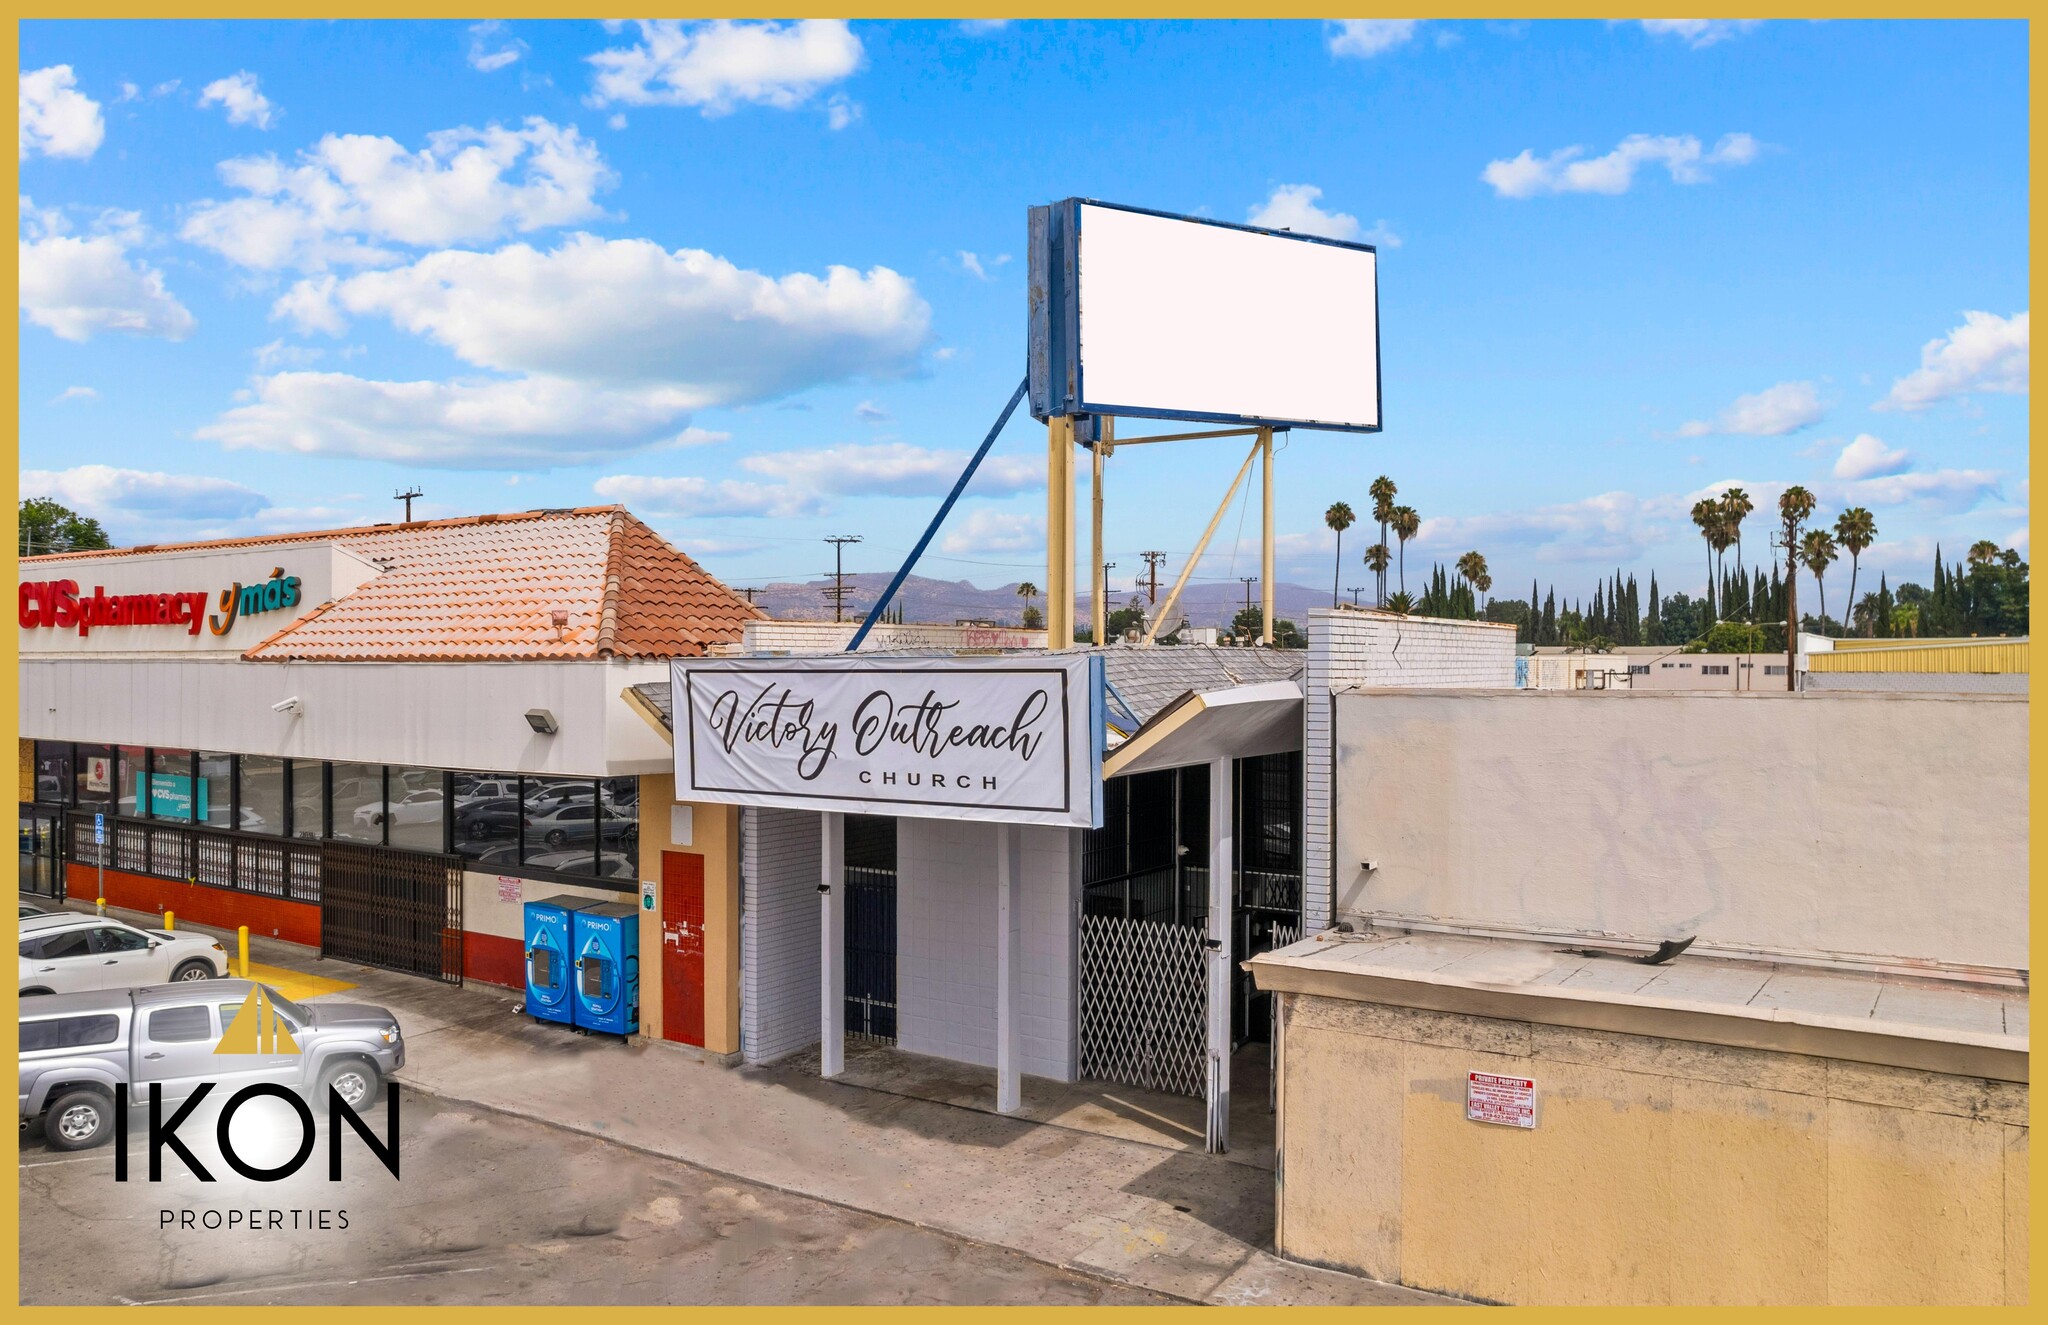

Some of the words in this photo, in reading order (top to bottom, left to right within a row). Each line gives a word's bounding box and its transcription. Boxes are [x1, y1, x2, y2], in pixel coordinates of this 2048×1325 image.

[709, 682, 837, 781] Victory
[852, 689, 1048, 761] Outreach
[858, 769, 998, 791] CHURCH
[535, 914, 557, 924] PRIMO
[587, 921, 610, 931] PRIMO
[1475, 1075, 1497, 1084] PRIVATE
[1498, 1078, 1527, 1087] PROPERTY
